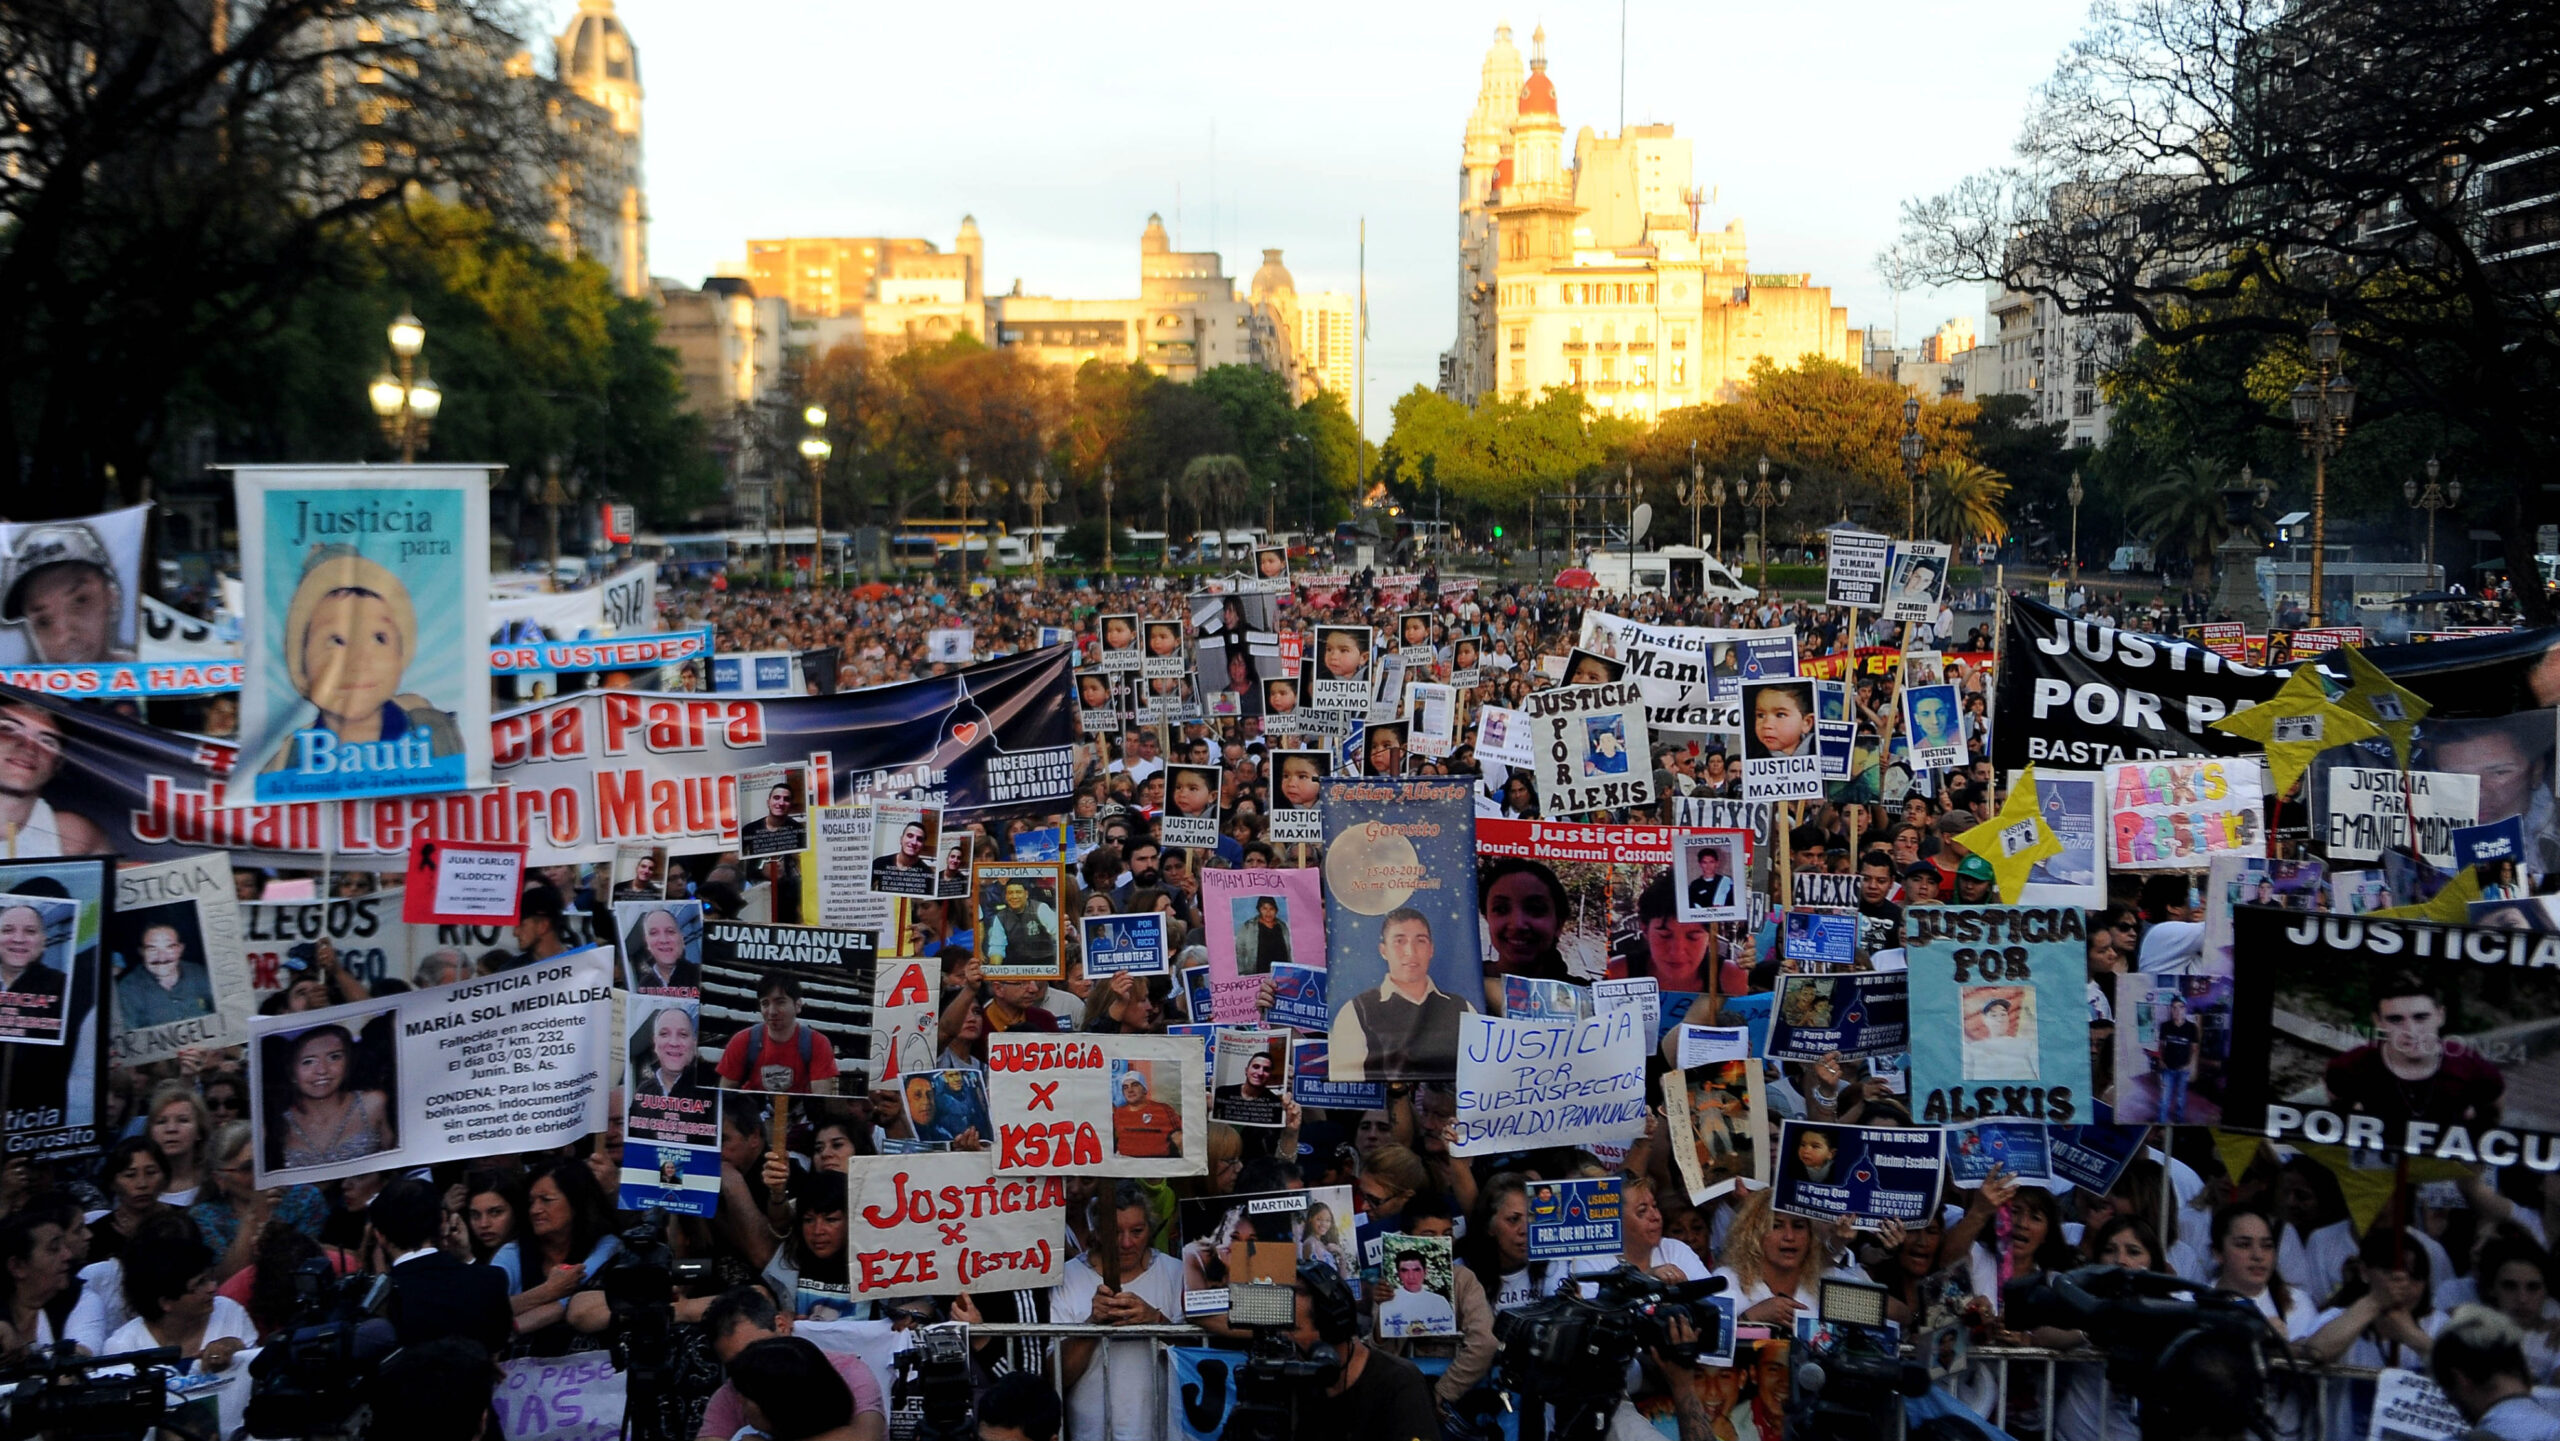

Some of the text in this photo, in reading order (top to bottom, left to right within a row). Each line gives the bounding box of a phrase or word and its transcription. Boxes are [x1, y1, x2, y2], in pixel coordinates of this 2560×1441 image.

[292, 499, 433, 546] Justicia
[399, 537, 453, 563] para
[1911, 545, 1936, 555] SELIN
[1897, 602, 1928, 612] CAMBIO
[2203, 625, 2241, 633] JUSTICIA
[2293, 633, 2339, 644] JUSTICIA
[548, 636, 707, 667] USTEDES!
[2292, 641, 2316, 649] POR
[1104, 661, 1139, 669] MAXIMO
[1147, 658, 1181, 666] JUSTICIA
[108, 669, 140, 691] A
[1317, 681, 1367, 693] JUSTICIA
[1529, 682, 1642, 718] JUSTICIA
[1678, 683, 1692, 701] y
[1316, 698, 1368, 708] MAXIMO
[2033, 677, 2167, 731] POR
[602, 692, 767, 757] Para
[294, 724, 434, 776] Bauti
[1921, 748, 1957, 758] JUSTICIA
[2028, 737, 2126, 765] BASTA
[1750, 758, 1816, 776] JUSTICIA
[1932, 757, 1954, 766] SELIN
[1330, 782, 1466, 802] Fabian Alberto
[1549, 780, 1648, 812] ALEXIS
[1749, 781, 1819, 797] MAXIMO
[337, 780, 584, 857] Leandro
[592, 750, 836, 848] Maugi
[824, 808, 850, 820] MIRIAM
[822, 822, 866, 835] NOGALES 18
[1166, 818, 1215, 830] JUSTICIA
[1366, 819, 1440, 842] Gorosito
[1165, 834, 1216, 845] MAXIMO
[1684, 837, 1731, 846] JUSTICIA
[448, 855, 516, 867] JUAN CARLOS
[1534, 843, 1608, 861] Moumni
[453, 872, 507, 882] KLODCZYK
[985, 866, 1029, 877] JUSTICIA
[1203, 869, 1285, 891] MIRIAM JESICA
[1352, 880, 1384, 890] No me
[1794, 874, 1862, 907] ALEXIS
[1907, 906, 2085, 947] JUSTICIA
[707, 925, 874, 951] JUAN MANUEL
[2285, 915, 2560, 970] JUSTICIA
[736, 942, 843, 965] MIRANDA
[1113, 952, 1124, 963] QUE
[1124, 952, 1132, 962] NO
[1953, 946, 2032, 983] POR
[447, 965, 572, 1003] JUSTICIA POR
[1598, 985, 1625, 997] FUERZA
[405, 986, 613, 1038] MARÍA SOL MEDIALDEA
[1293, 1000, 1306, 1014] QUE
[1306, 1002, 1316, 1015] NO
[439, 1014, 586, 1050] Fallecida en accidente
[1467, 1012, 1632, 1064] JUSTICIA
[462, 1030, 564, 1057] Ruta 7 km. 232
[448, 1060, 462, 1072] El
[487, 1042, 577, 1064] 03/03/2016
[513, 1060, 558, 1074] Bs. As.
[989, 1041, 1105, 1073] JUSTICIA
[1511, 1062, 1573, 1089] POR
[425, 1086, 497, 1107] CONDENA:
[499, 1082, 529, 1098] Para
[532, 1080, 551, 1093] los
[1323, 1081, 1358, 1094] QUE NO TE
[1456, 1065, 1645, 1113] SUBINSPECTOR
[1923, 1085, 2076, 1123] ALEXIS
[443, 1110, 529, 1131] sin carnet de
[1457, 1107, 1555, 1147] OSVALDO
[6, 1128, 96, 1153] Gorosito
[447, 1134, 465, 1144] en
[467, 1128, 512, 1143] estado
[515, 1123, 532, 1136] de
[1882, 1132, 1892, 1142] YA
[1894, 1132, 1906, 1143] ME
[2264, 1103, 2560, 1173] POR FACU
[1000, 1121, 1103, 1170] KSTA
[1808, 1185, 1830, 1197] Para
[1250, 1199, 1303, 1212] MARTINA
[1559, 1225, 1595, 1242] QUE NO TE
[857, 1238, 1052, 1294] EZE (KSTA)
[538, 1356, 616, 1389] PASE
